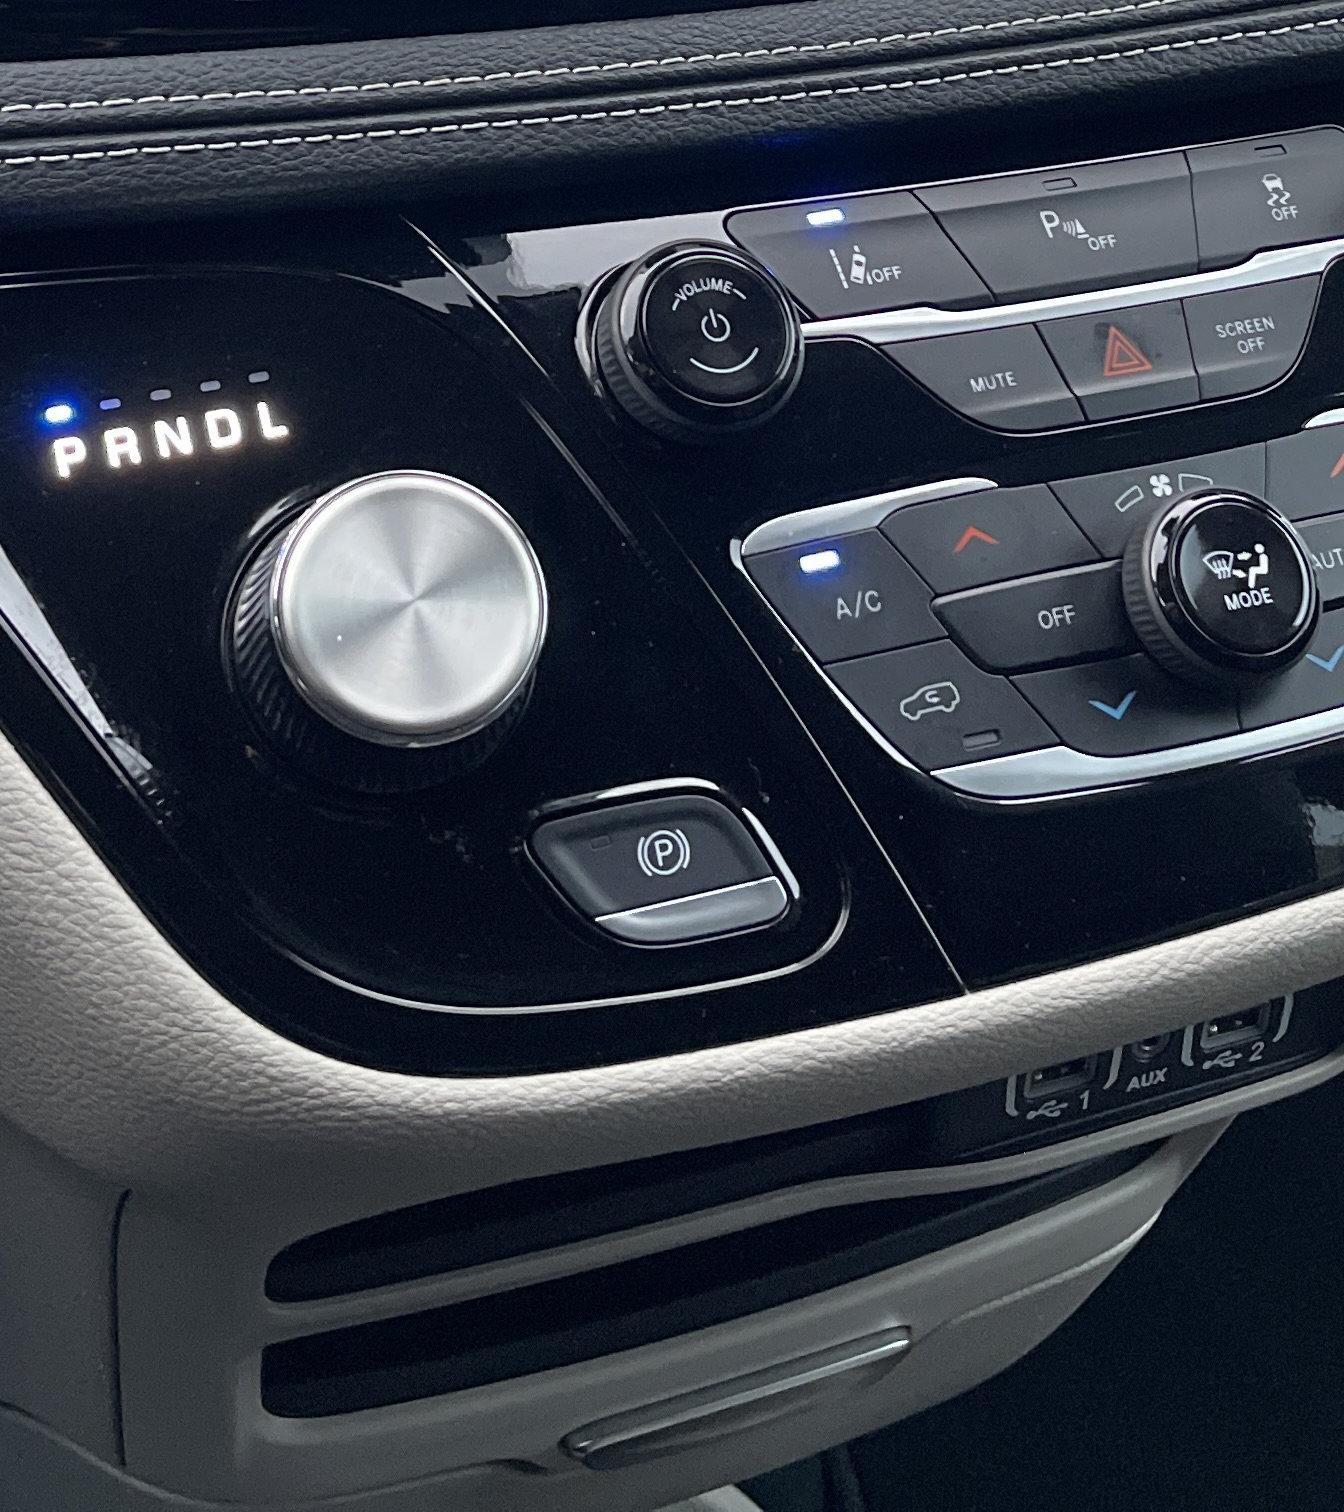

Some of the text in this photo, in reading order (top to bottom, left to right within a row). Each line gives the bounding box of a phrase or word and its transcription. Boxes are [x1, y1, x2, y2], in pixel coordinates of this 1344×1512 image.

[1271, 205, 1298, 221] OFF
[1087, 234, 1117, 251] OFF
[871, 265, 902, 283] OFF
[674, 277, 734, 303] VOLUME
[1215, 316, 1275, 338] SCREEN
[1237, 337, 1265, 355] OFF
[969, 371, 1018, 393] MUTE
[835, 590, 882, 620] A/C
[1223, 587, 1274, 611] MODE
[1037, 604, 1076, 630] OFF
[1126, 1067, 1168, 1092] AUX
